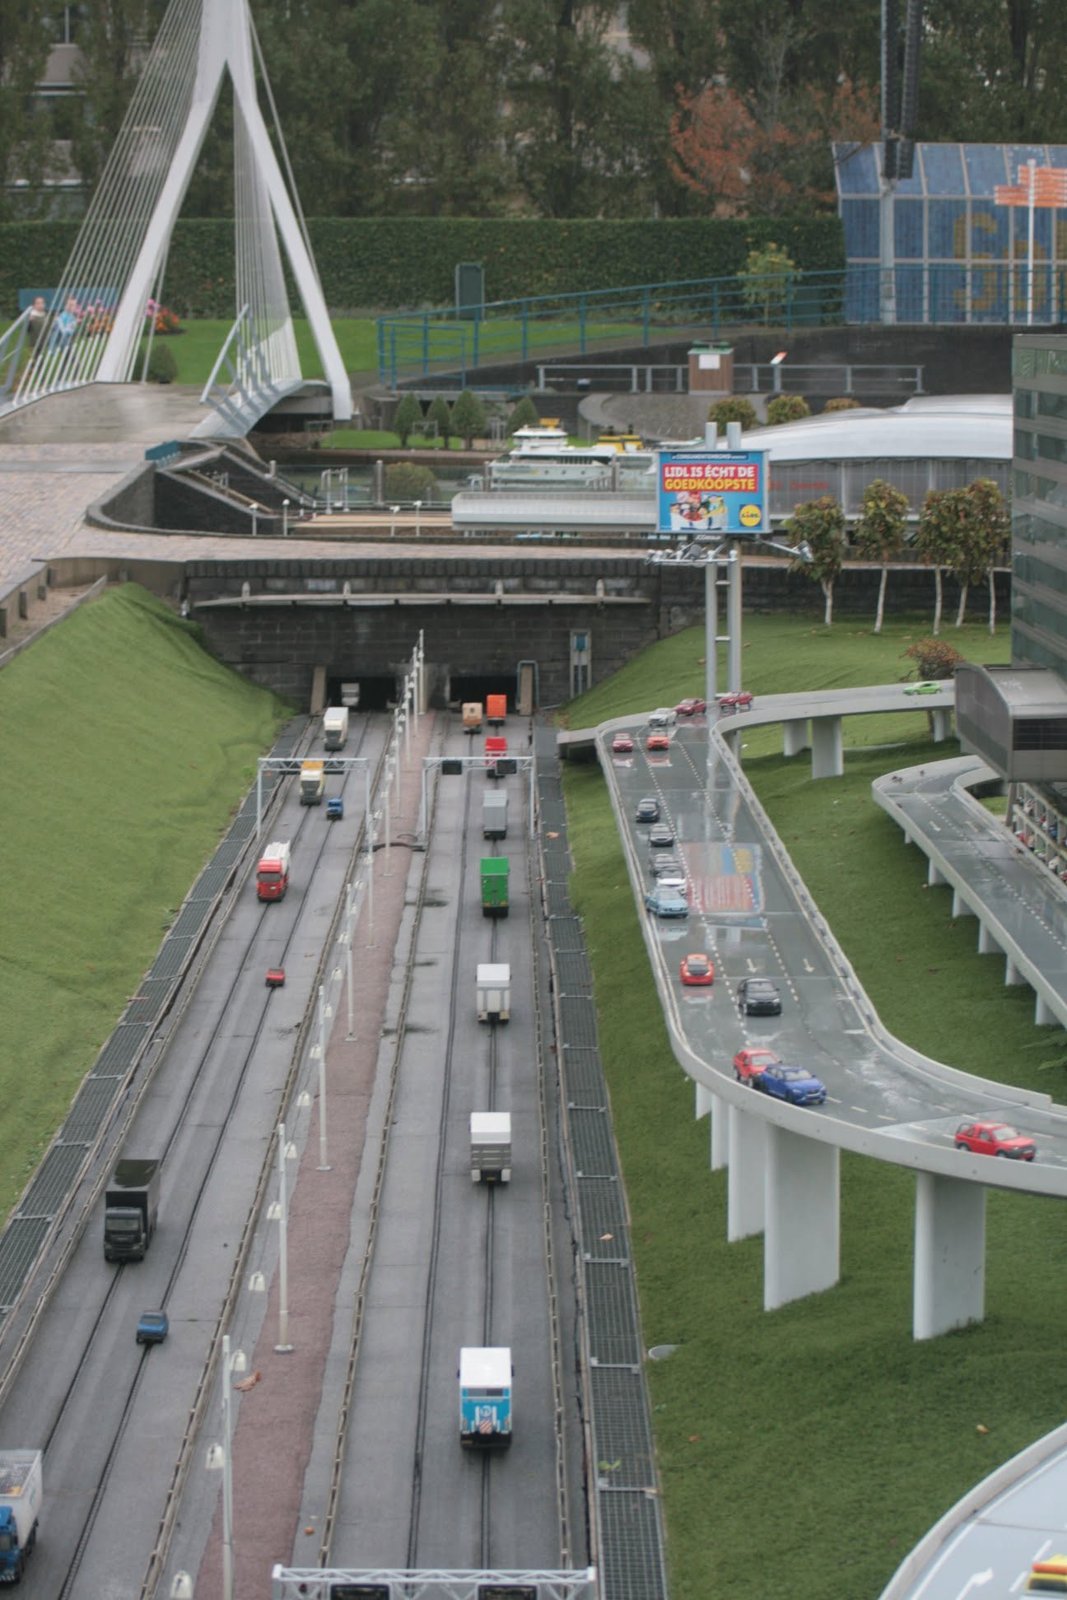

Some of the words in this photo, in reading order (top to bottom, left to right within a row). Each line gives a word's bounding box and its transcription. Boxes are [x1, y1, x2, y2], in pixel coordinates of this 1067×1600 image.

[664, 466, 690, 478] LIDL
[690, 466, 703, 478] IS
[704, 464, 735, 478] ÉCHT
[737, 466, 755, 478] DE
